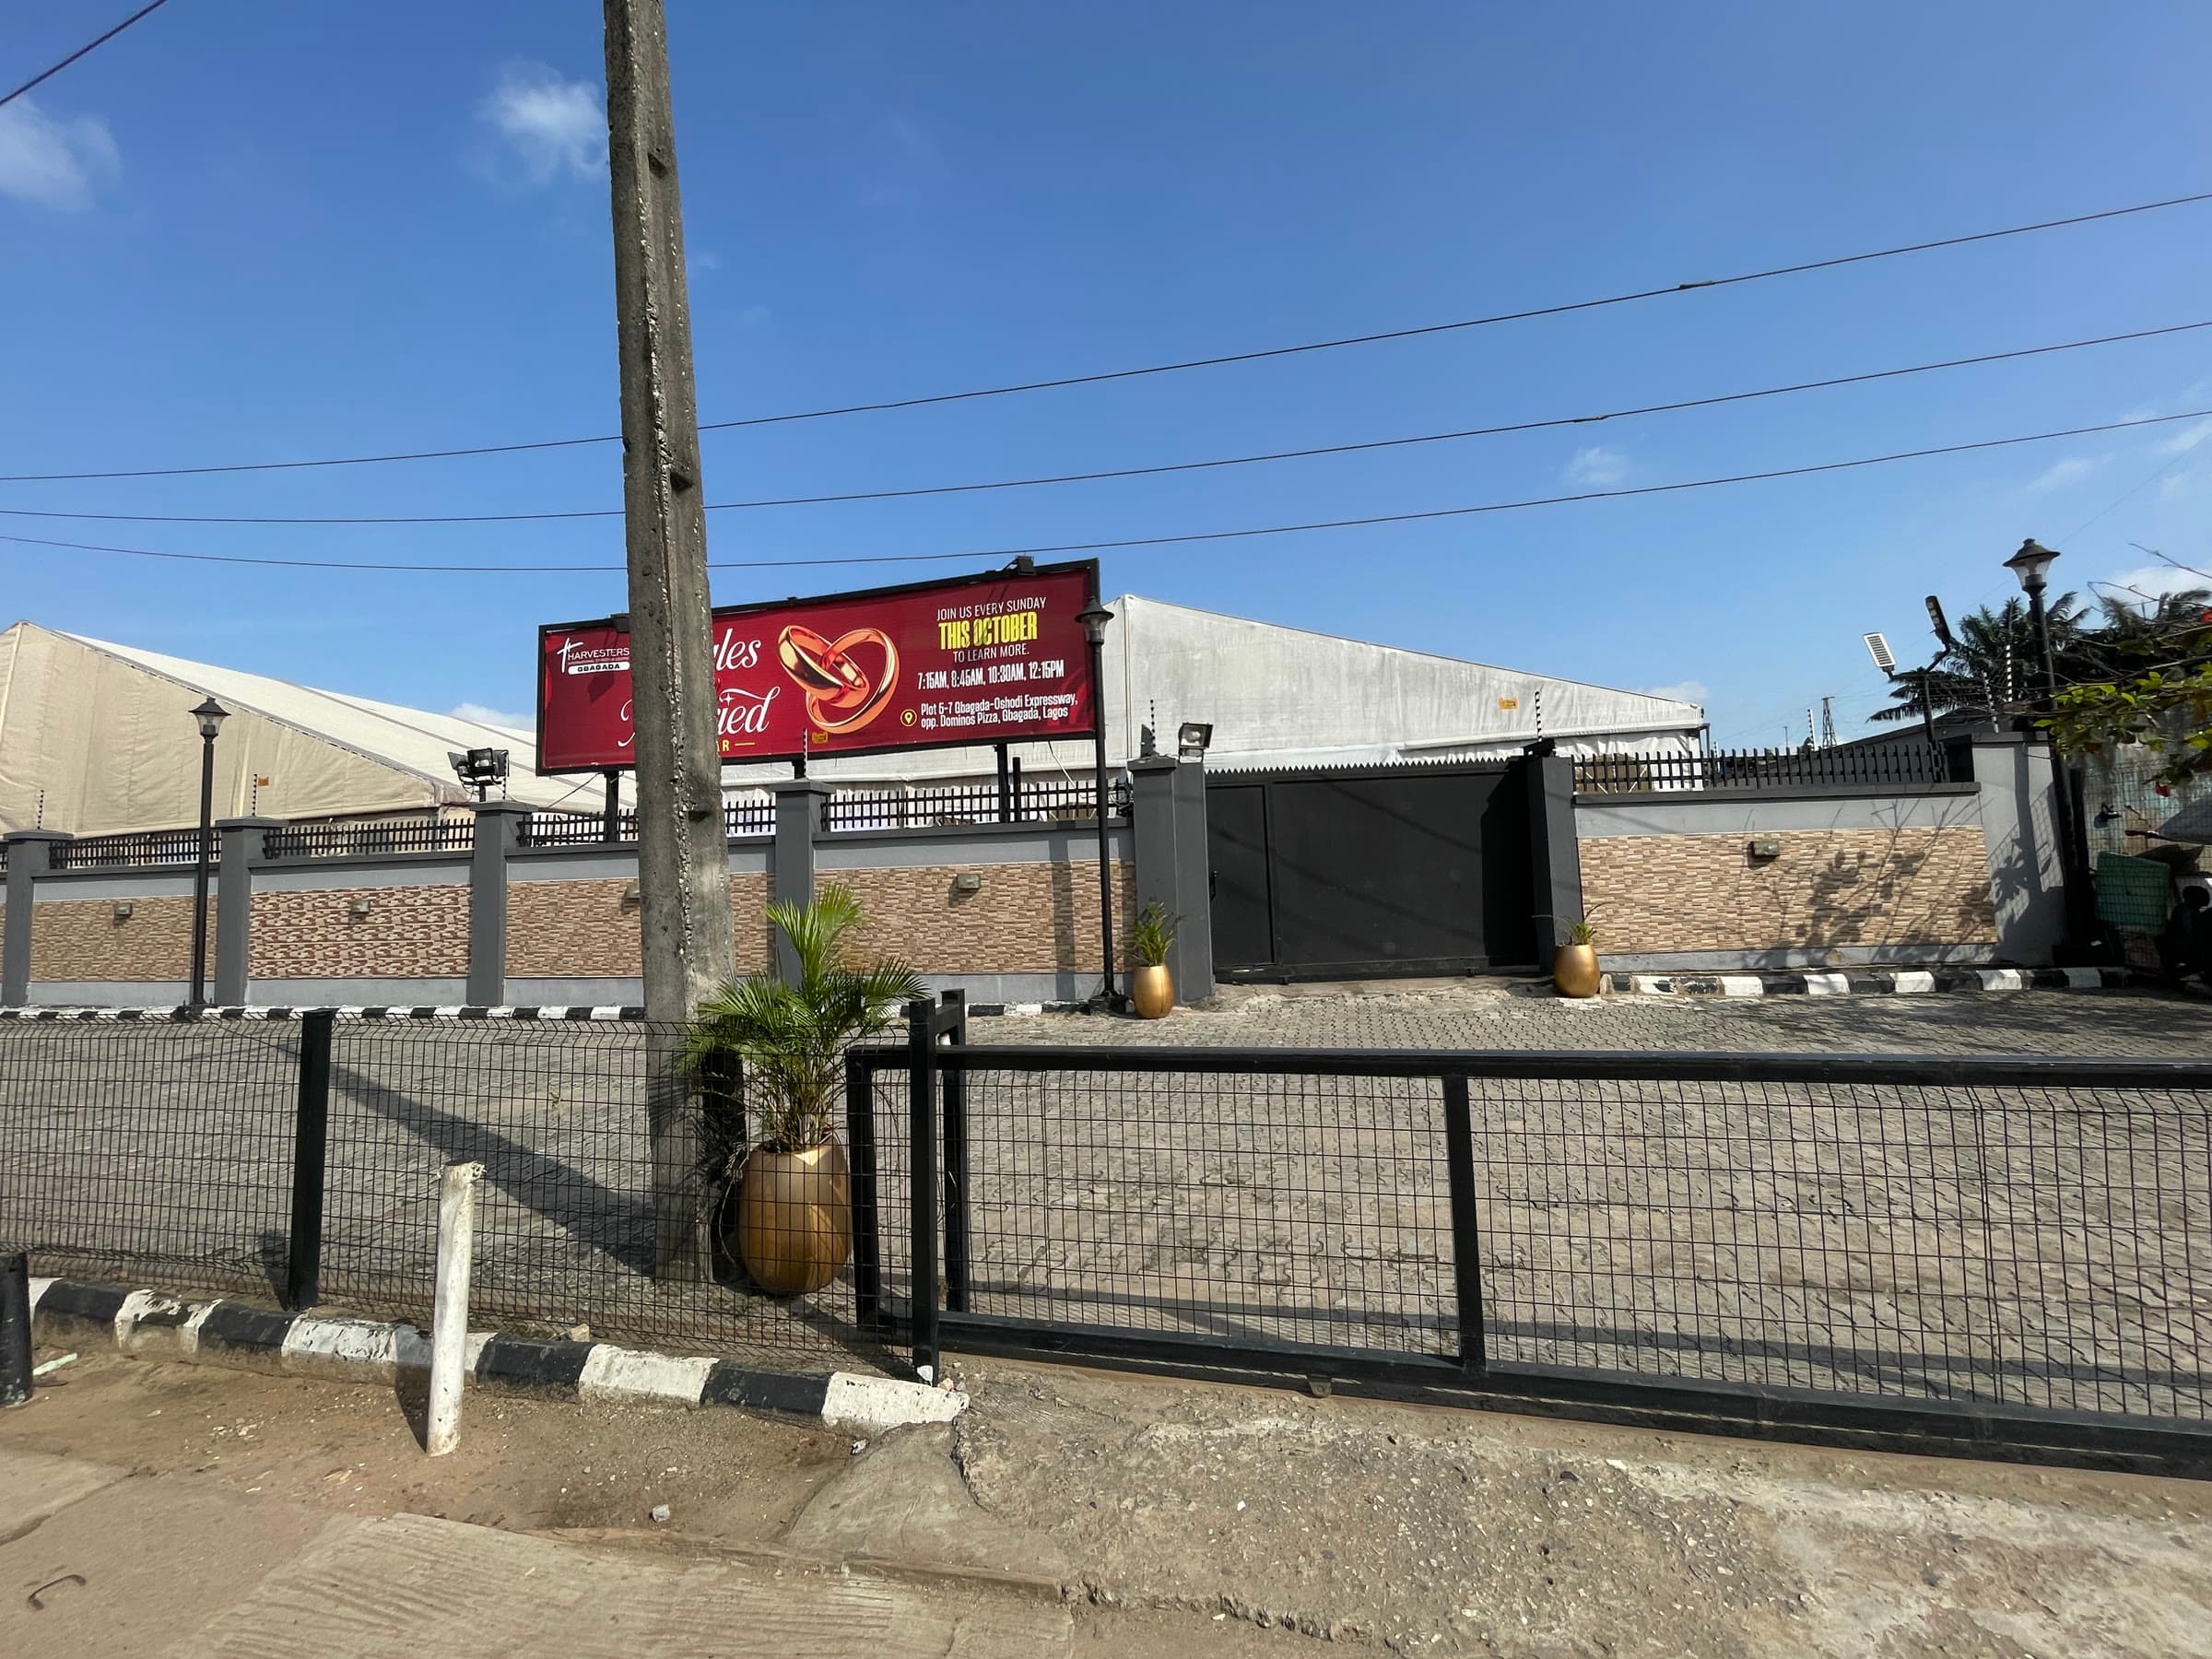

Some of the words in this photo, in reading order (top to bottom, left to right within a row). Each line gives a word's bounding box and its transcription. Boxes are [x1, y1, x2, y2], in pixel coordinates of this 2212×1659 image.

[937, 608, 957, 621] JOIN
[959, 606, 972, 618] US
[975, 601, 1004, 616] EVERY
[1006, 597, 1047, 612] SUNDAY
[938, 620, 970, 650] THIS
[973, 612, 1037, 646] OCTOBER
[568, 647, 630, 660] HARVESTERS
[713, 628, 761, 671] les
[953, 650, 965, 663] TO
[968, 647, 997, 662] LEARN
[1000, 643, 1030, 658] MORE.
[577, 664, 620, 672] GBAGADA
[918, 671, 949, 690] 7:15AM,
[951, 668, 986, 687] 8:45AM,
[988, 663, 1026, 683] 10:30AM,
[1029, 659, 1064, 678] 12:15PM
[921, 703, 936, 716] Plot
[955, 697, 1023, 715] Gbagada-Oshodi
[1025, 693, 1078, 709] Expressway,
[921, 718, 939, 730] opp.
[941, 714, 975, 727] Dominos
[977, 712, 1000, 724] Pizza,
[1002, 708, 1041, 724] Gbagada,
[1043, 706, 1068, 720] Lagos
